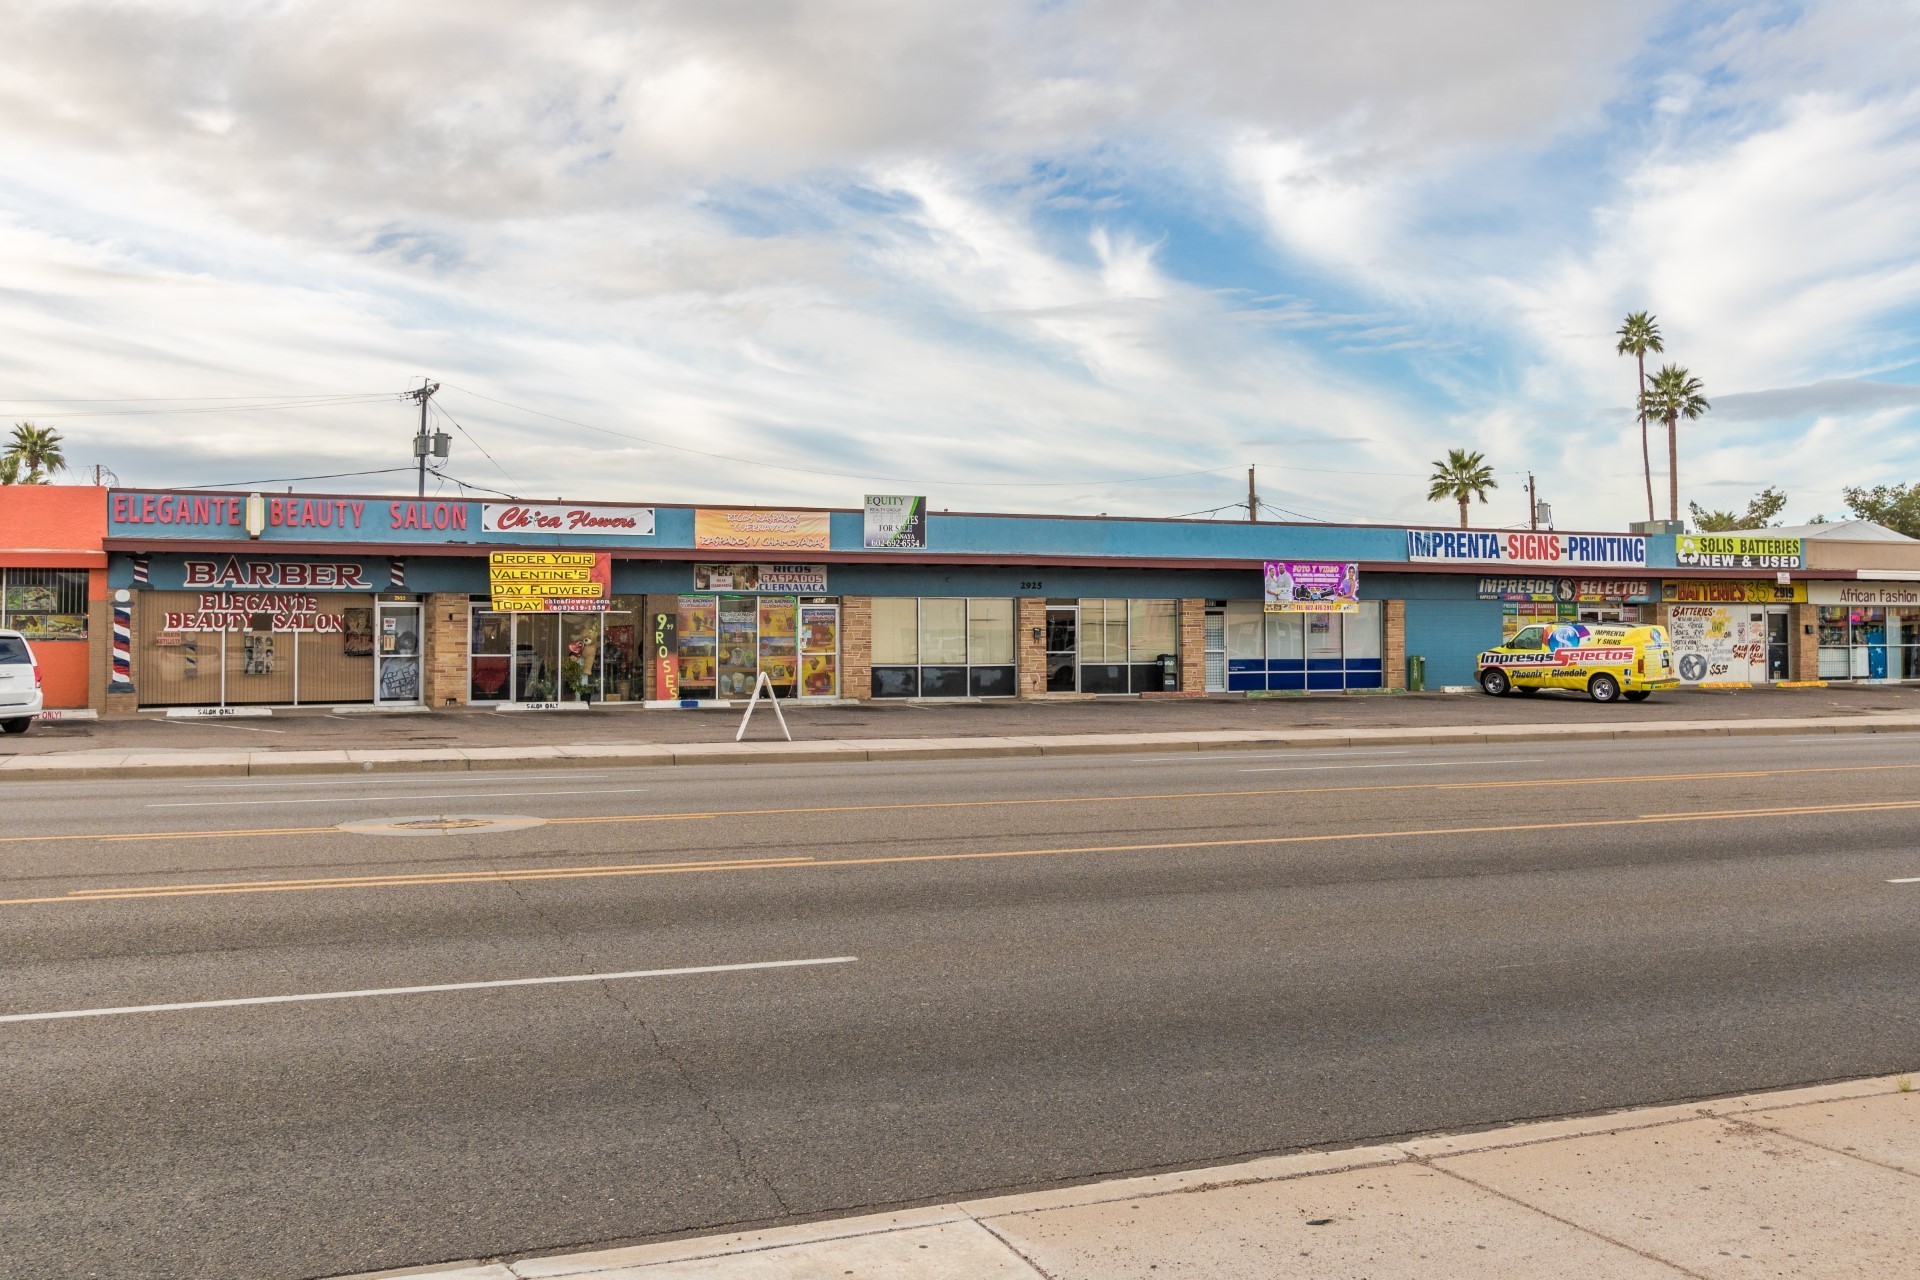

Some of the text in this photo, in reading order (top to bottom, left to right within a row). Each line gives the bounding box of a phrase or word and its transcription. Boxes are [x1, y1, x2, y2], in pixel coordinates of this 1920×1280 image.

[866, 496, 904, 506] EQUITY
[113, 495, 467, 530] ELEGANTE BEAUTY SALON
[726, 512, 801, 524] RICOS RASPADOS
[566, 510, 636, 530] Flowers
[700, 536, 750, 547] RASPADOS
[752, 537, 760, 546] Y
[1700, 538, 1799, 554] SOLIS BATTERIES
[492, 553, 592, 564] ORDER YOUR
[1700, 555, 1799, 568] NEW & USED
[183, 555, 373, 590] BARBER
[491, 569, 588, 580] VALENTINE'S
[1293, 565, 1310, 573] FOTO
[762, 574, 823, 583] RASPADOS
[494, 585, 600, 595] DAY FLOWERS
[1479, 579, 1650, 594] IMPRESOS SELECTOS
[1677, 580, 1745, 602] BATTERIES
[1774, 587, 1794, 598] 2919
[1840, 588, 1918, 603] African Fashion
[198, 592, 317, 613] ELEGANTE
[494, 600, 541, 611] TODAY
[1672, 606, 1712, 617] BATTERIES
[164, 612, 344, 633] BEAUTY SALON
[1732, 644, 1748, 653] CASH
[1750, 644, 1760, 652] NO
[1554, 648, 1634, 666] Selectos
[1512, 670, 1543, 678] Phoenix
[1552, 669, 1587, 678] Glendale
[42, 711, 62, 720] ONLY!
